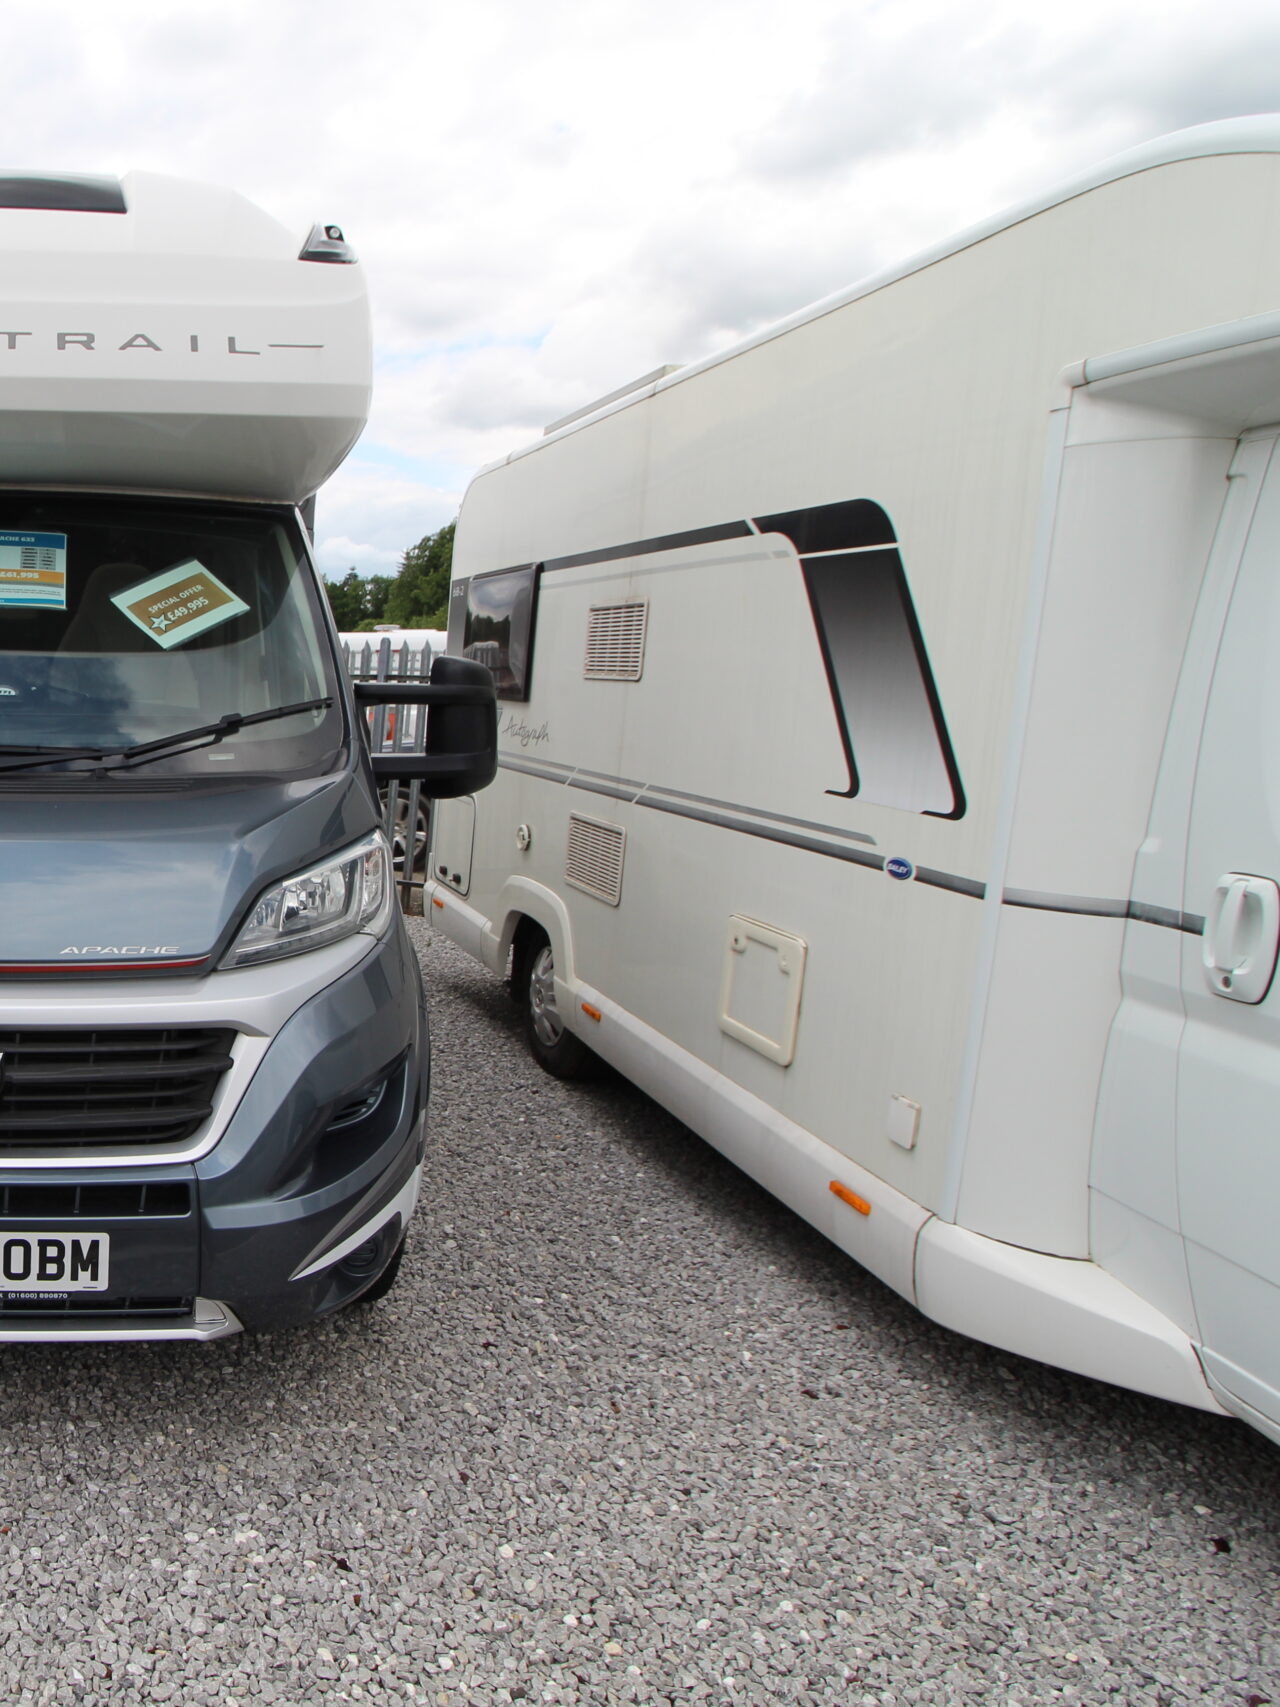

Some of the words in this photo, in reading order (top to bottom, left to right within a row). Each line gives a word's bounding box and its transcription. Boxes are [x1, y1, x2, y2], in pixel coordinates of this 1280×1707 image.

[148, 596, 180, 614] SPECIAL
[179, 584, 204, 599] OFFER
[167, 596, 209, 621] £49,995
[502, 716, 550, 747] Autograph
[60, 946, 180, 954] APACHE
[2, 1238, 100, 1282] OBM
